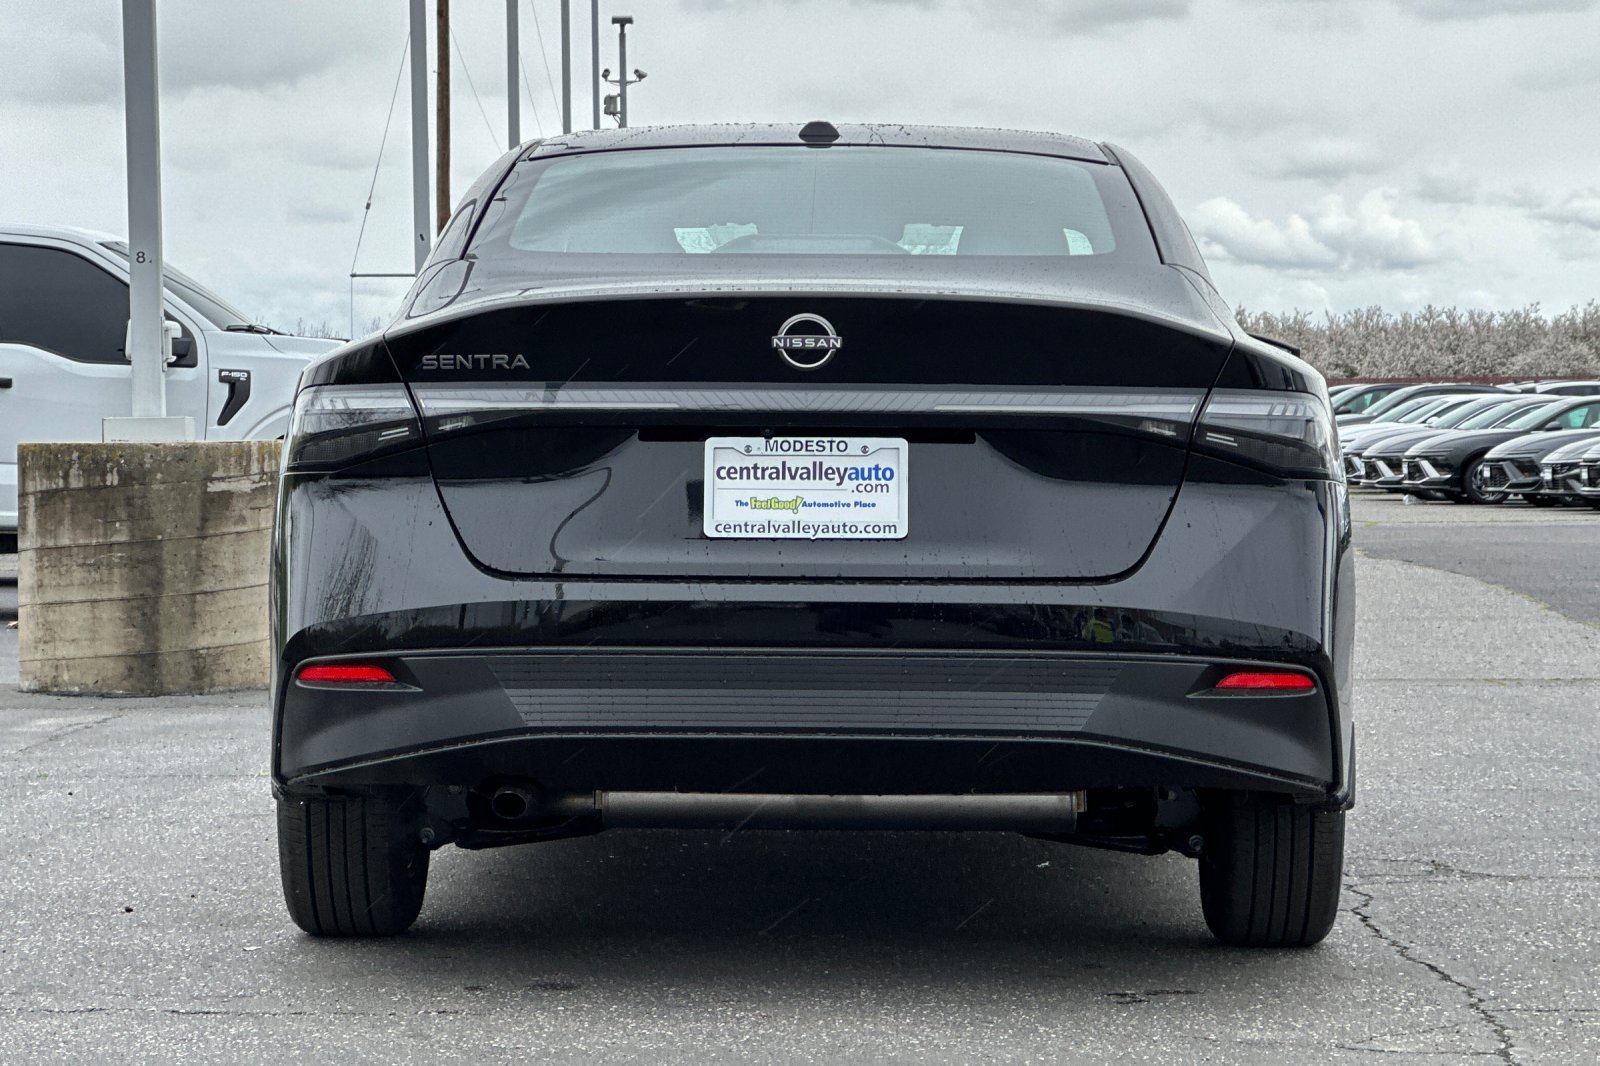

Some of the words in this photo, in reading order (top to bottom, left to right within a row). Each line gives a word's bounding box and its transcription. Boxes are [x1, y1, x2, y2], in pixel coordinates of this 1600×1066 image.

[773, 338, 841, 348] NISSAN
[422, 354, 531, 370] SENTRA
[765, 440, 848, 453] MODESTO
[716, 461, 895, 486] centralvalleyauto
[851, 483, 890, 493] .com
[802, 500, 851, 508] Automotive
[715, 520, 897, 537] centralvalleyauto.com
